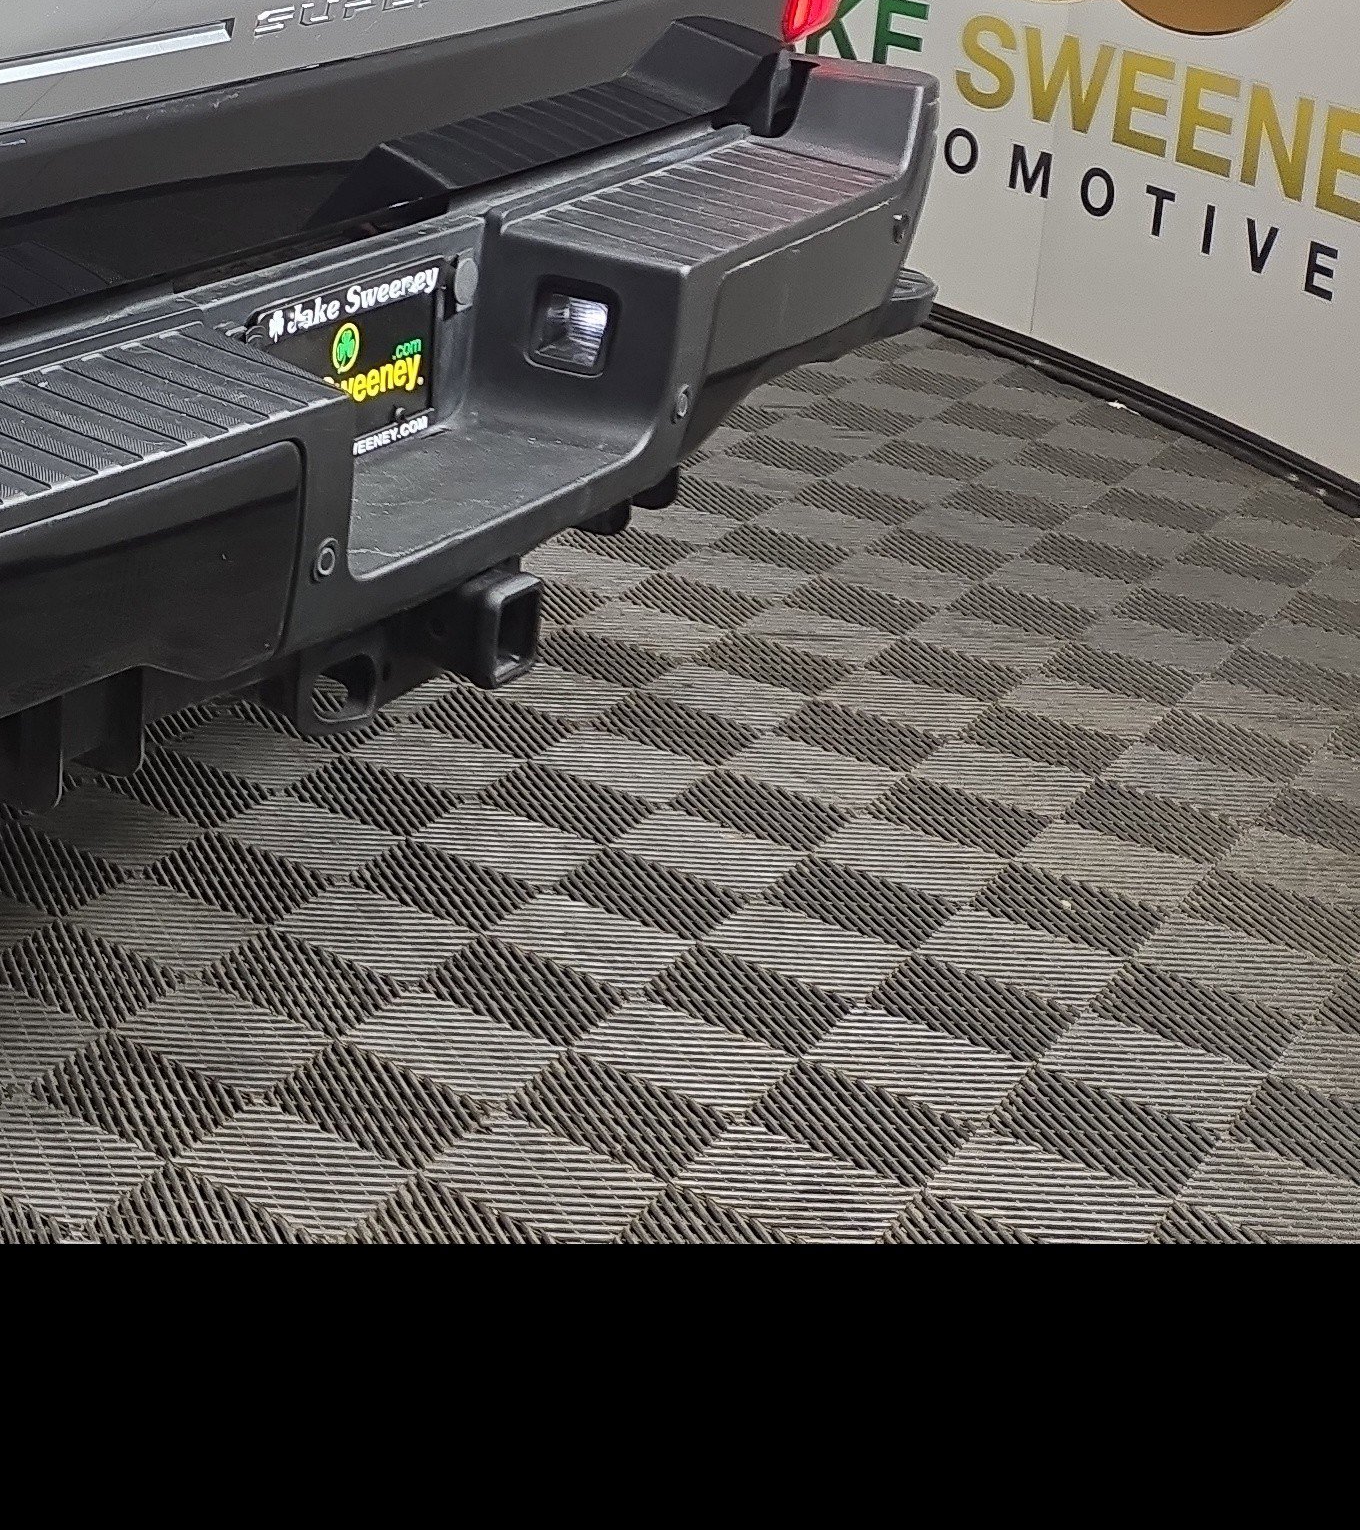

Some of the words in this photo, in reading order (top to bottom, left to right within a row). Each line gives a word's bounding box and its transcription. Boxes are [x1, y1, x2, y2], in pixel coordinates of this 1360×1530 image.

[955, 14, 1360, 225] SWEENE
[944, 127, 1339, 302] OMOTIVE
[287, 296, 341, 334] Jake
[344, 266, 440, 314] Sweeney
[392, 338, 422, 361] .com
